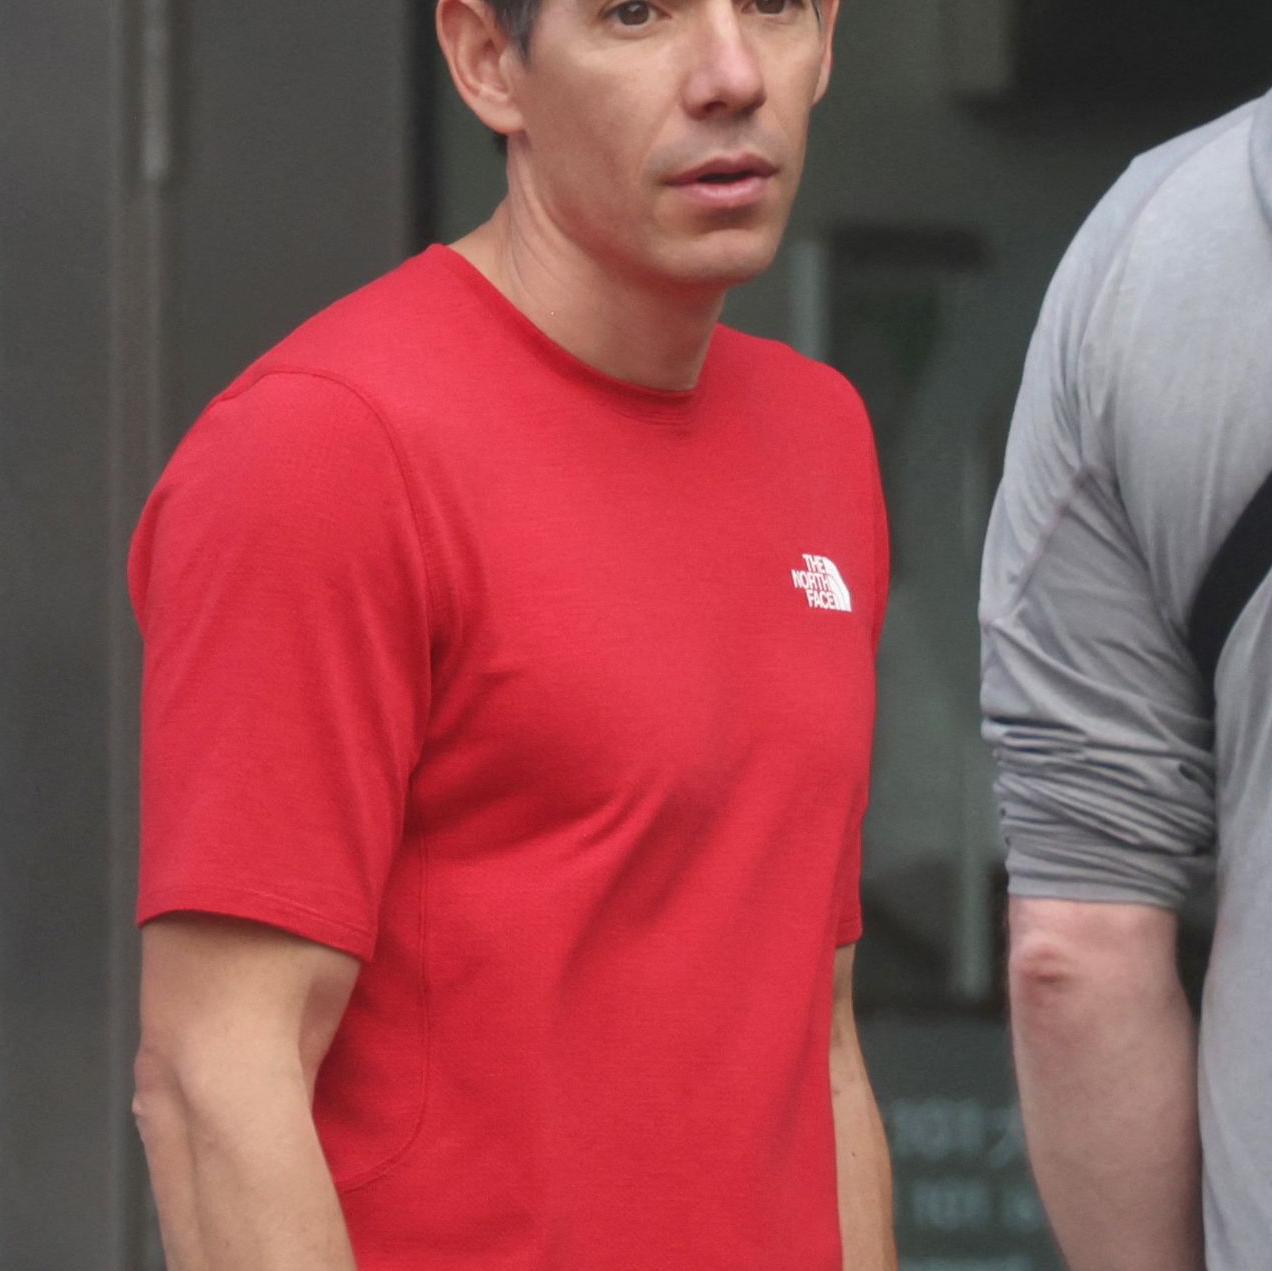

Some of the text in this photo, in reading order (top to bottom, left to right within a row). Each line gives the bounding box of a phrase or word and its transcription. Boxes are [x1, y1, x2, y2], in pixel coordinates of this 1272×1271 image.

[802, 554, 827, 574] THE
[791, 569, 832, 592] NORTH
[806, 589, 837, 610] FACE
